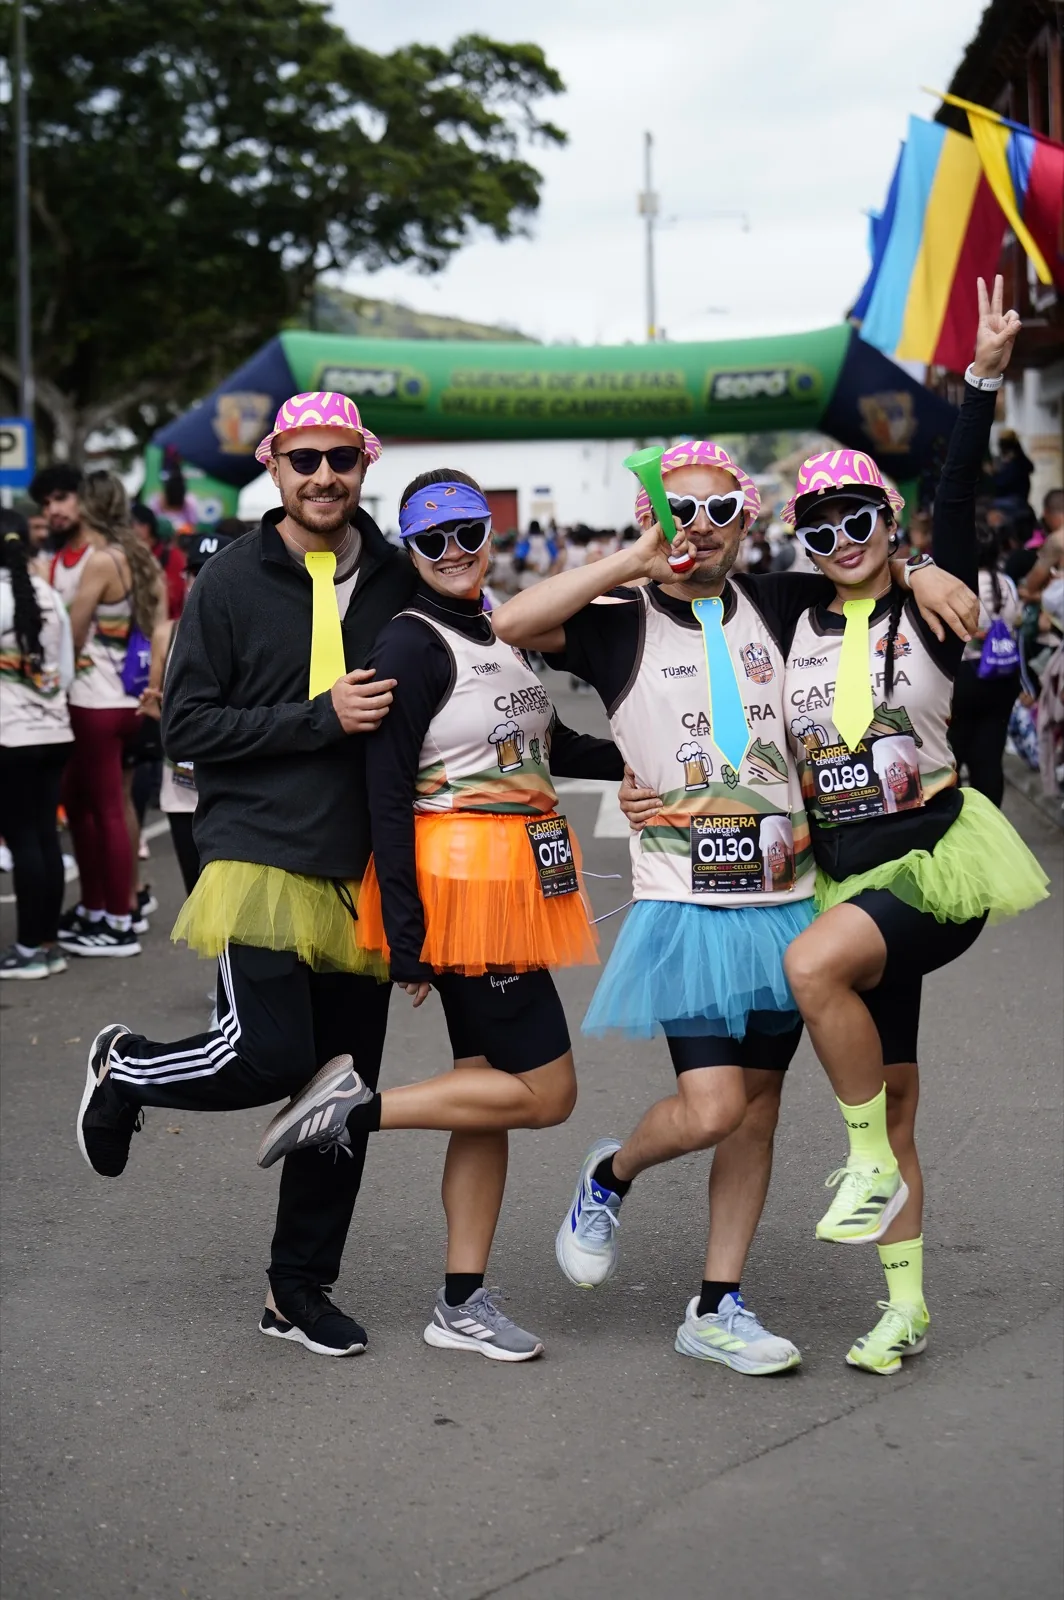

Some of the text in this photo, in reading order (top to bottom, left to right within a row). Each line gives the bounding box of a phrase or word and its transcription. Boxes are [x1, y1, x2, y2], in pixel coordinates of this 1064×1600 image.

[547, 370, 577, 390] DE
[513, 395, 547, 416] DE
[199, 538, 219, 553] N
[815, 754, 851, 767] CERVECERA
[818, 763, 869, 793] 0189
[693, 816, 757, 829] CARRERA
[533, 829, 563, 840] CERVECERA
[538, 839, 573, 867] 0754
[697, 837, 755, 863] 0130
